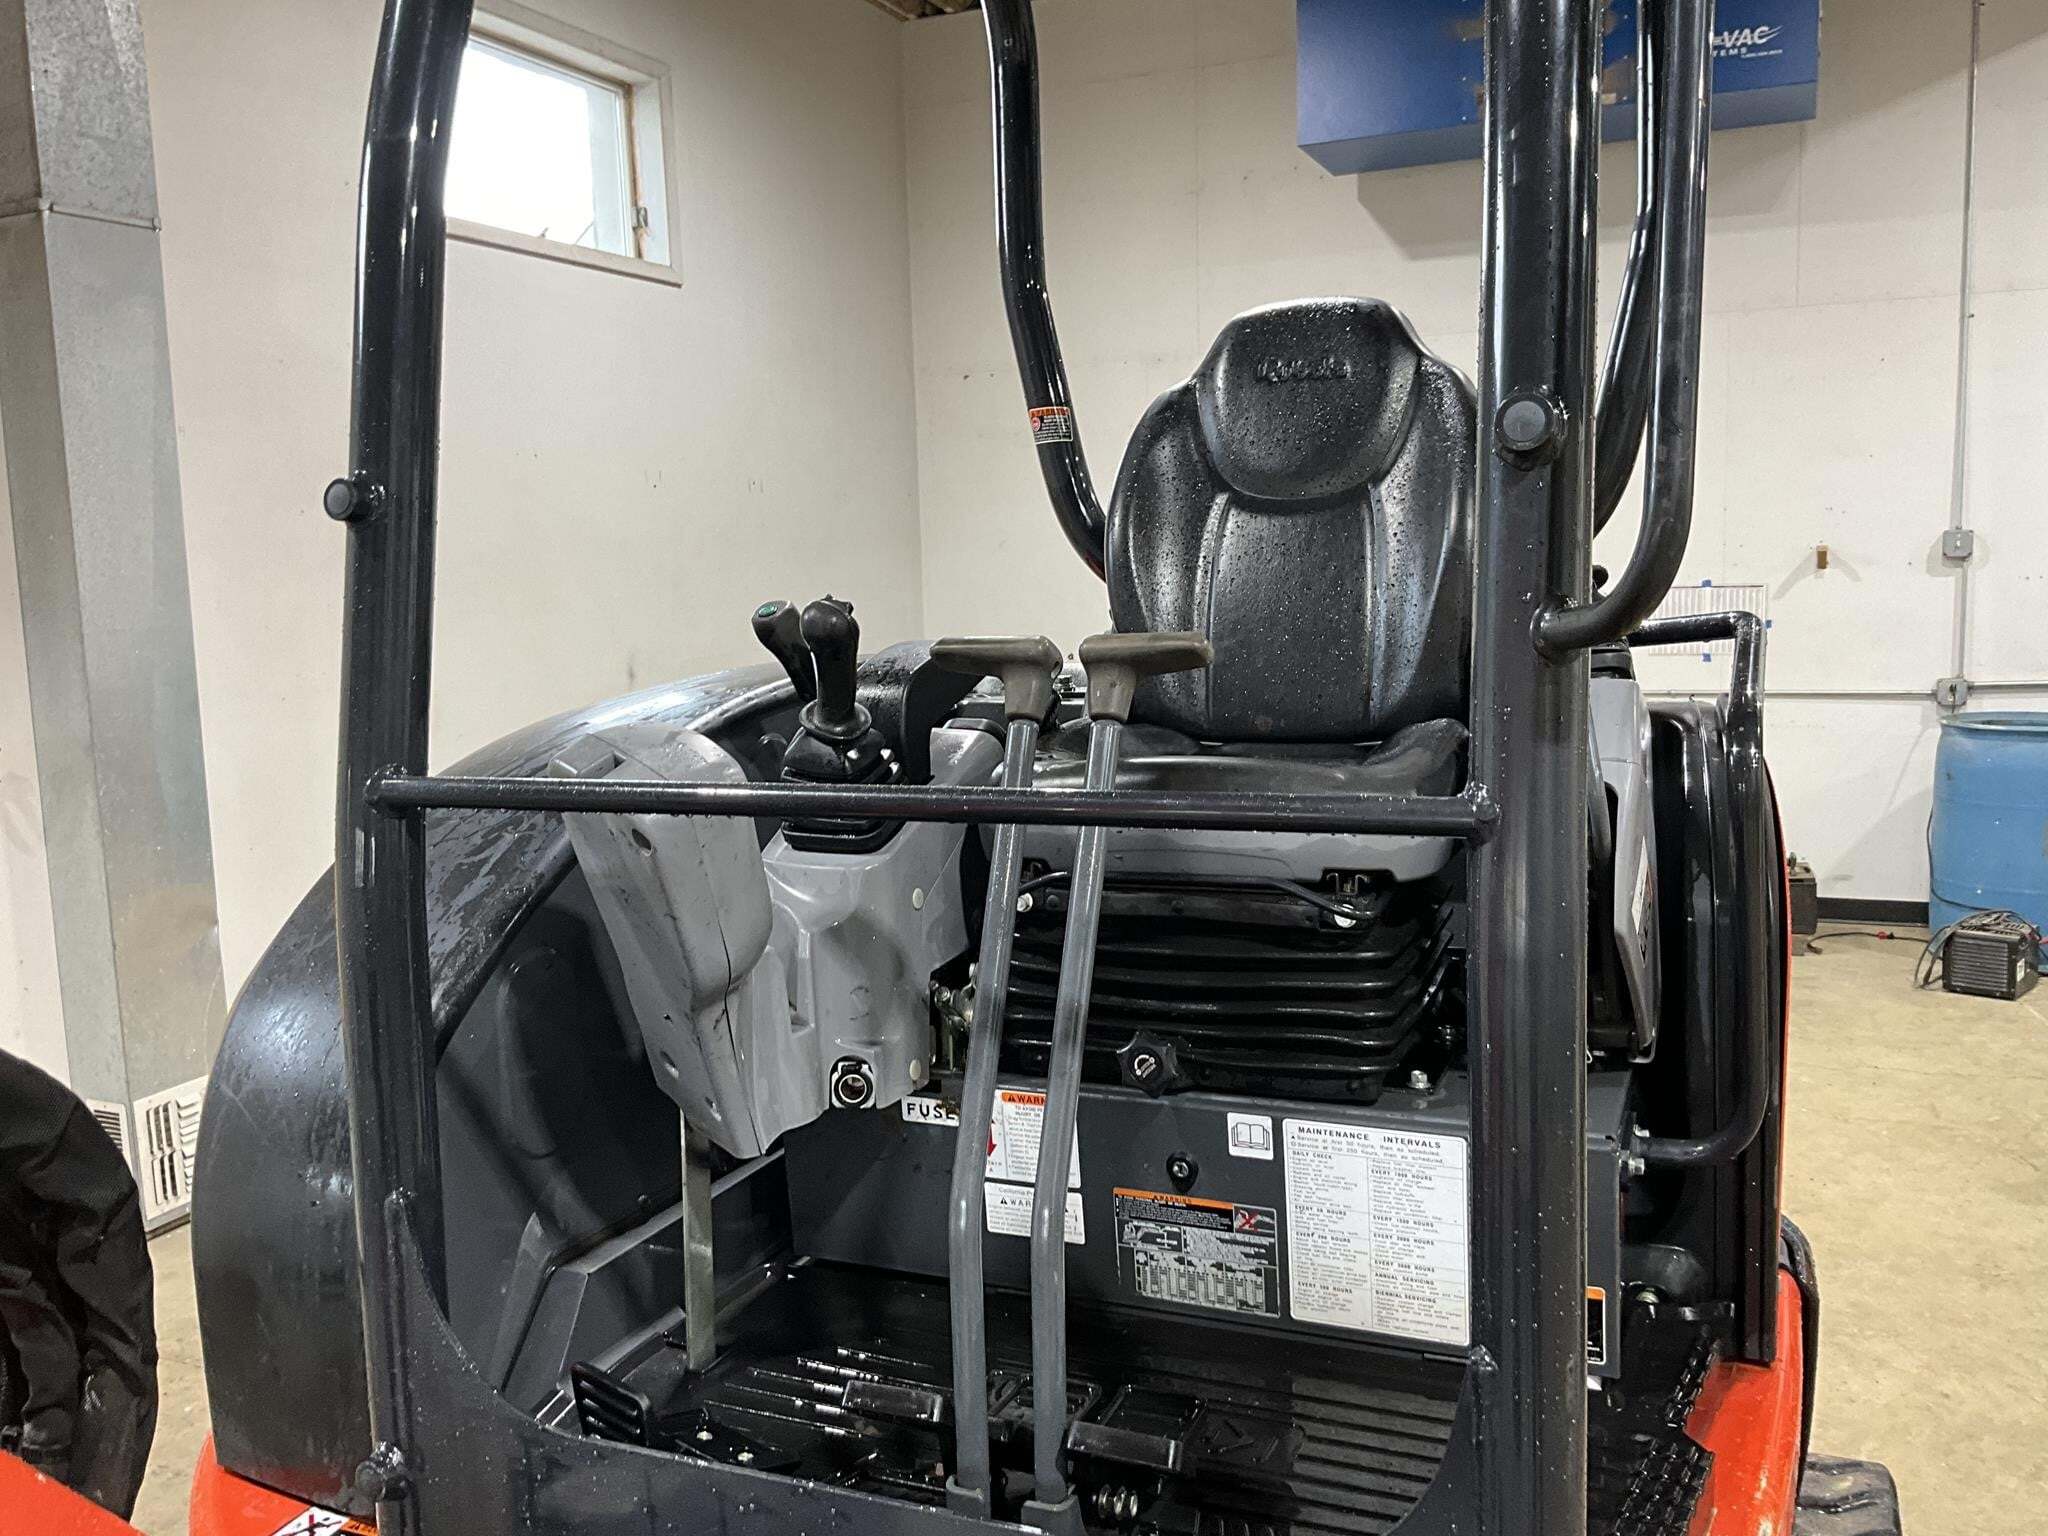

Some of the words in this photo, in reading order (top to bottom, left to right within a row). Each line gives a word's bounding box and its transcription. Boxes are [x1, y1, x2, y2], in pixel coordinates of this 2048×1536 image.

[1298, 1126, 1370, 1141] MAINTENANCE
[1383, 1136, 1441, 1149] INTERVALS
[1312, 1152, 1333, 1160] CHECK
[1375, 1272, 1399, 1281] ANNUAL
[1402, 1275, 1435, 1286] SERVICING
